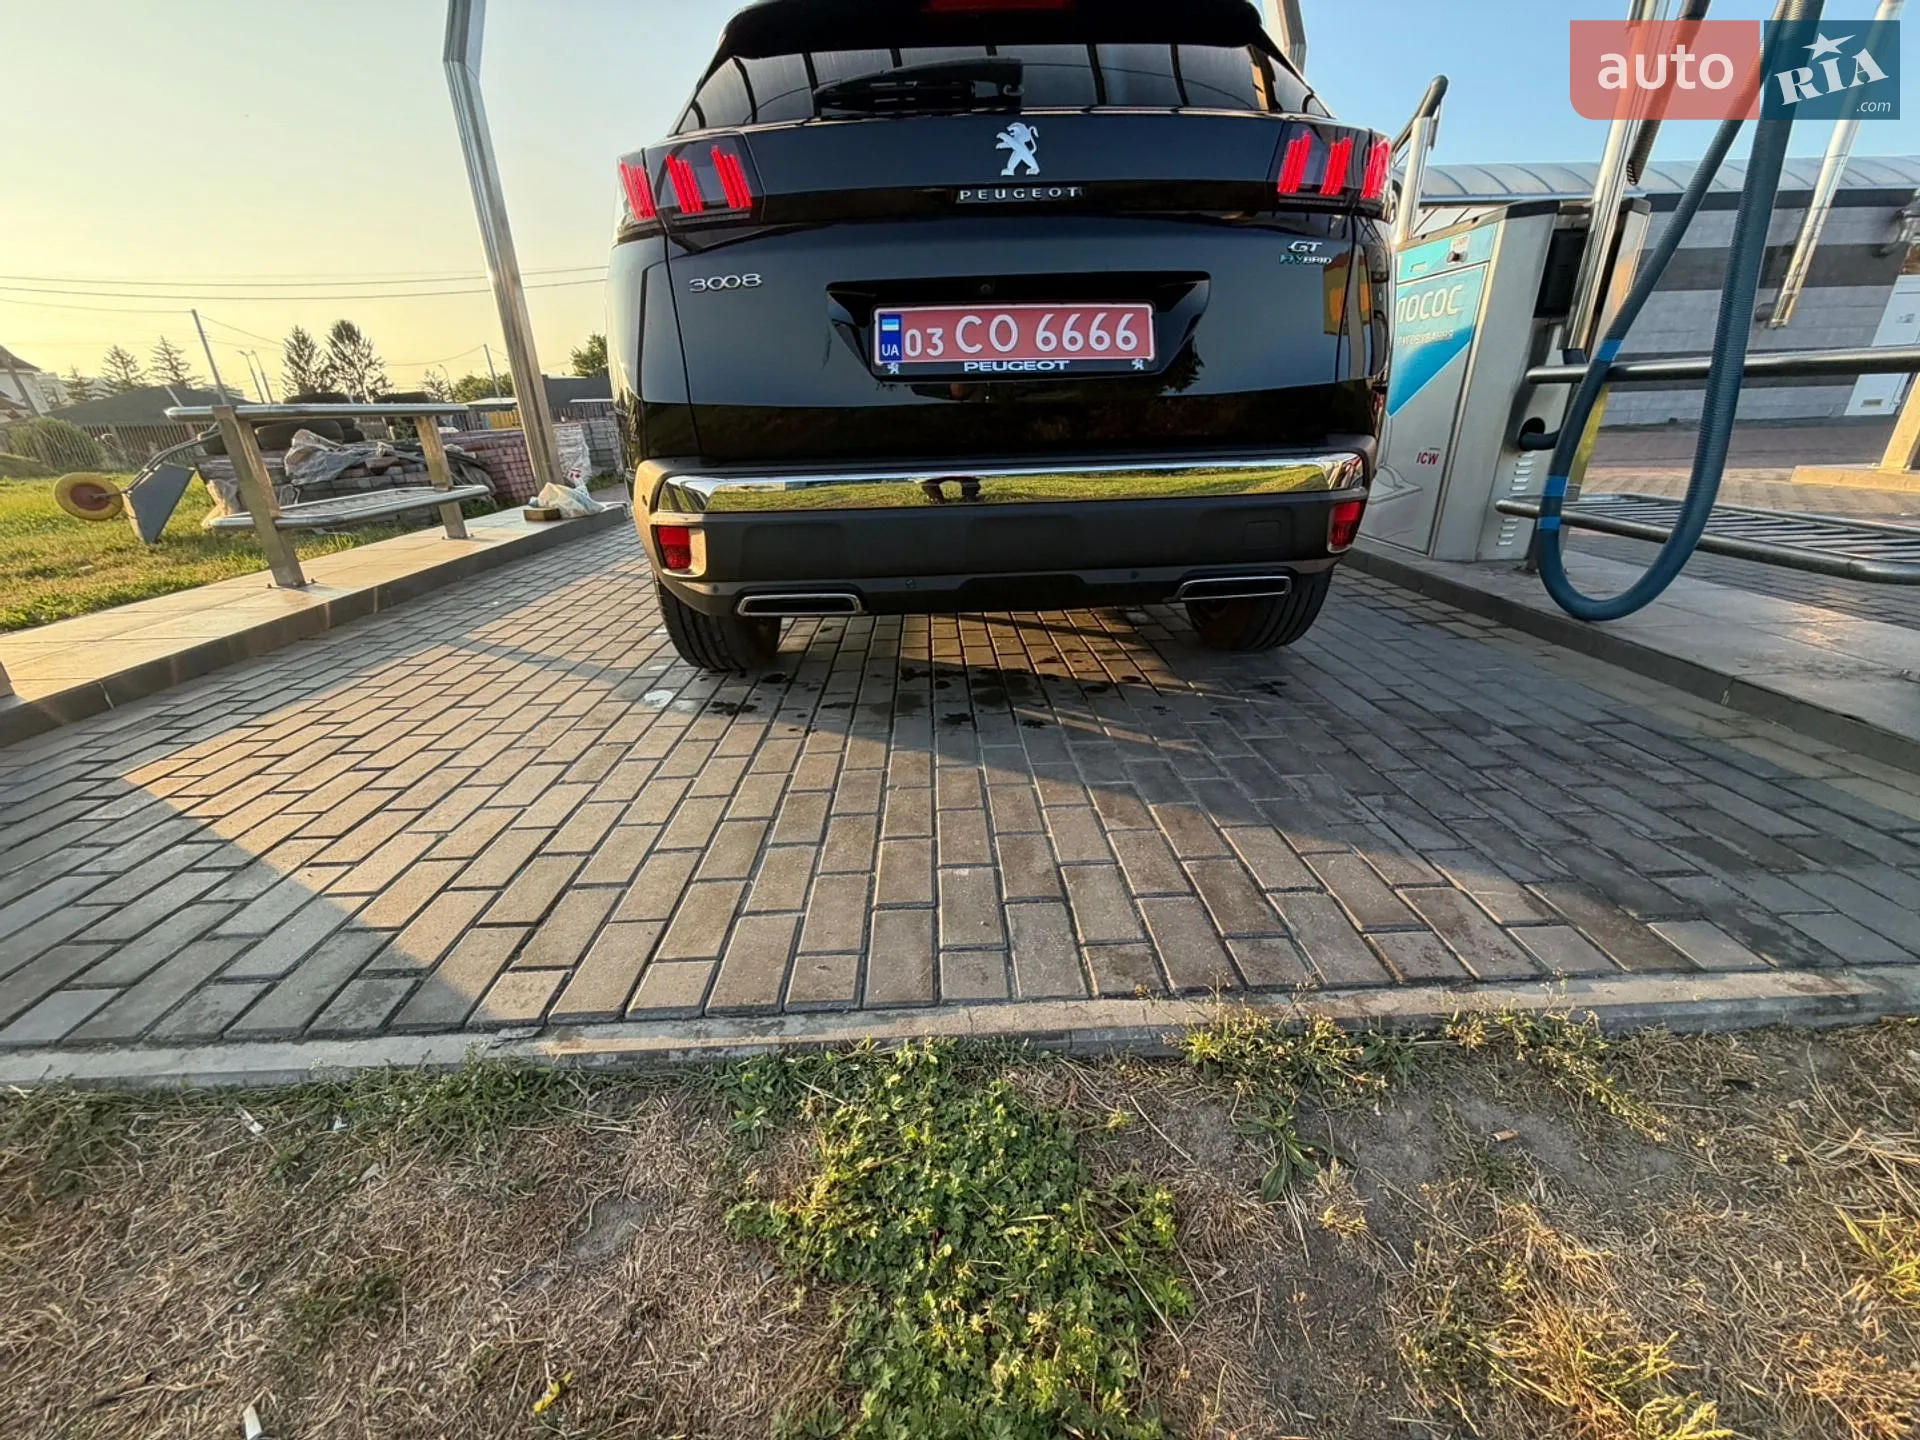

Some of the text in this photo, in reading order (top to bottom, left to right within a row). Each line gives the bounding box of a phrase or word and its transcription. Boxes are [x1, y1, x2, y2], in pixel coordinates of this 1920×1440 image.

[959, 186, 1080, 200] PEUGEOT
[1288, 241, 1323, 252] GT
[688, 273, 763, 292] 3008
[904, 312, 1138, 357] 03 CO 6666
[881, 343, 900, 356] UA
[963, 360, 1070, 372] PEUGEOT
[1416, 452, 1439, 465] ICW
